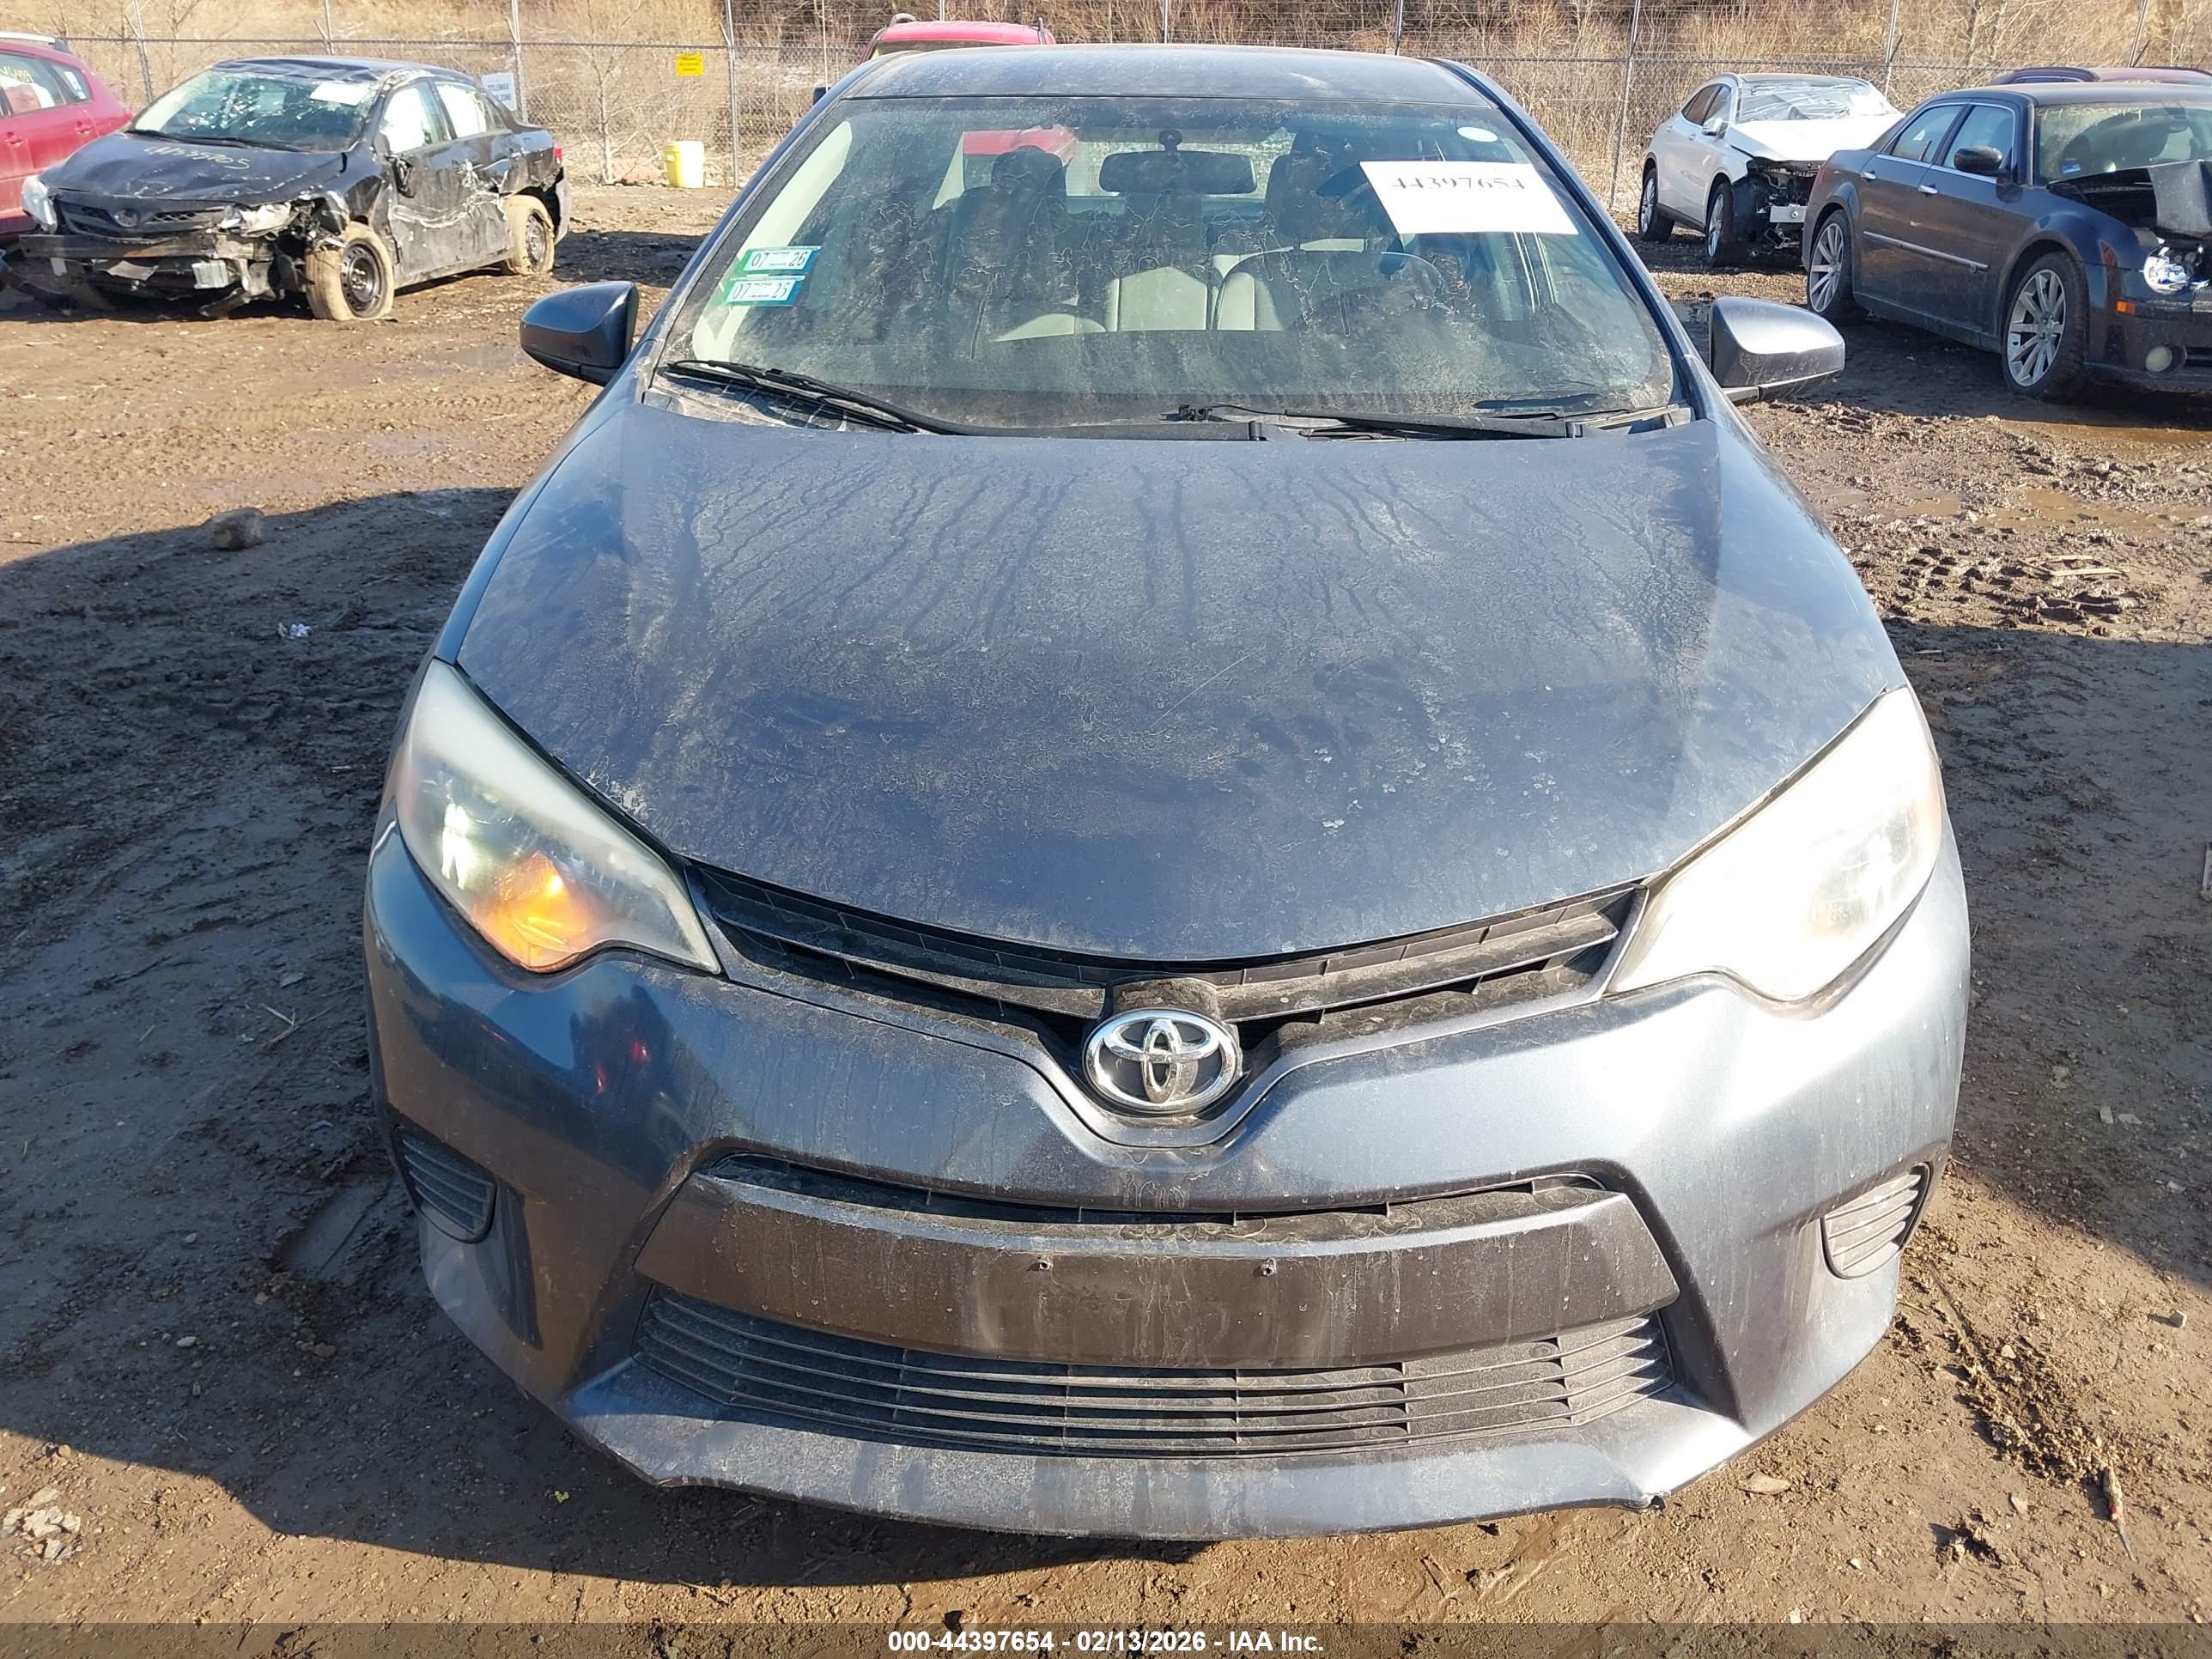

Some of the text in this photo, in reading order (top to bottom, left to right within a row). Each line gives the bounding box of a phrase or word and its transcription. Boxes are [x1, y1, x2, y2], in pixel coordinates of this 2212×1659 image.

[1393, 177, 1525, 189] 44397654
[751, 252, 807, 267] 07 26
